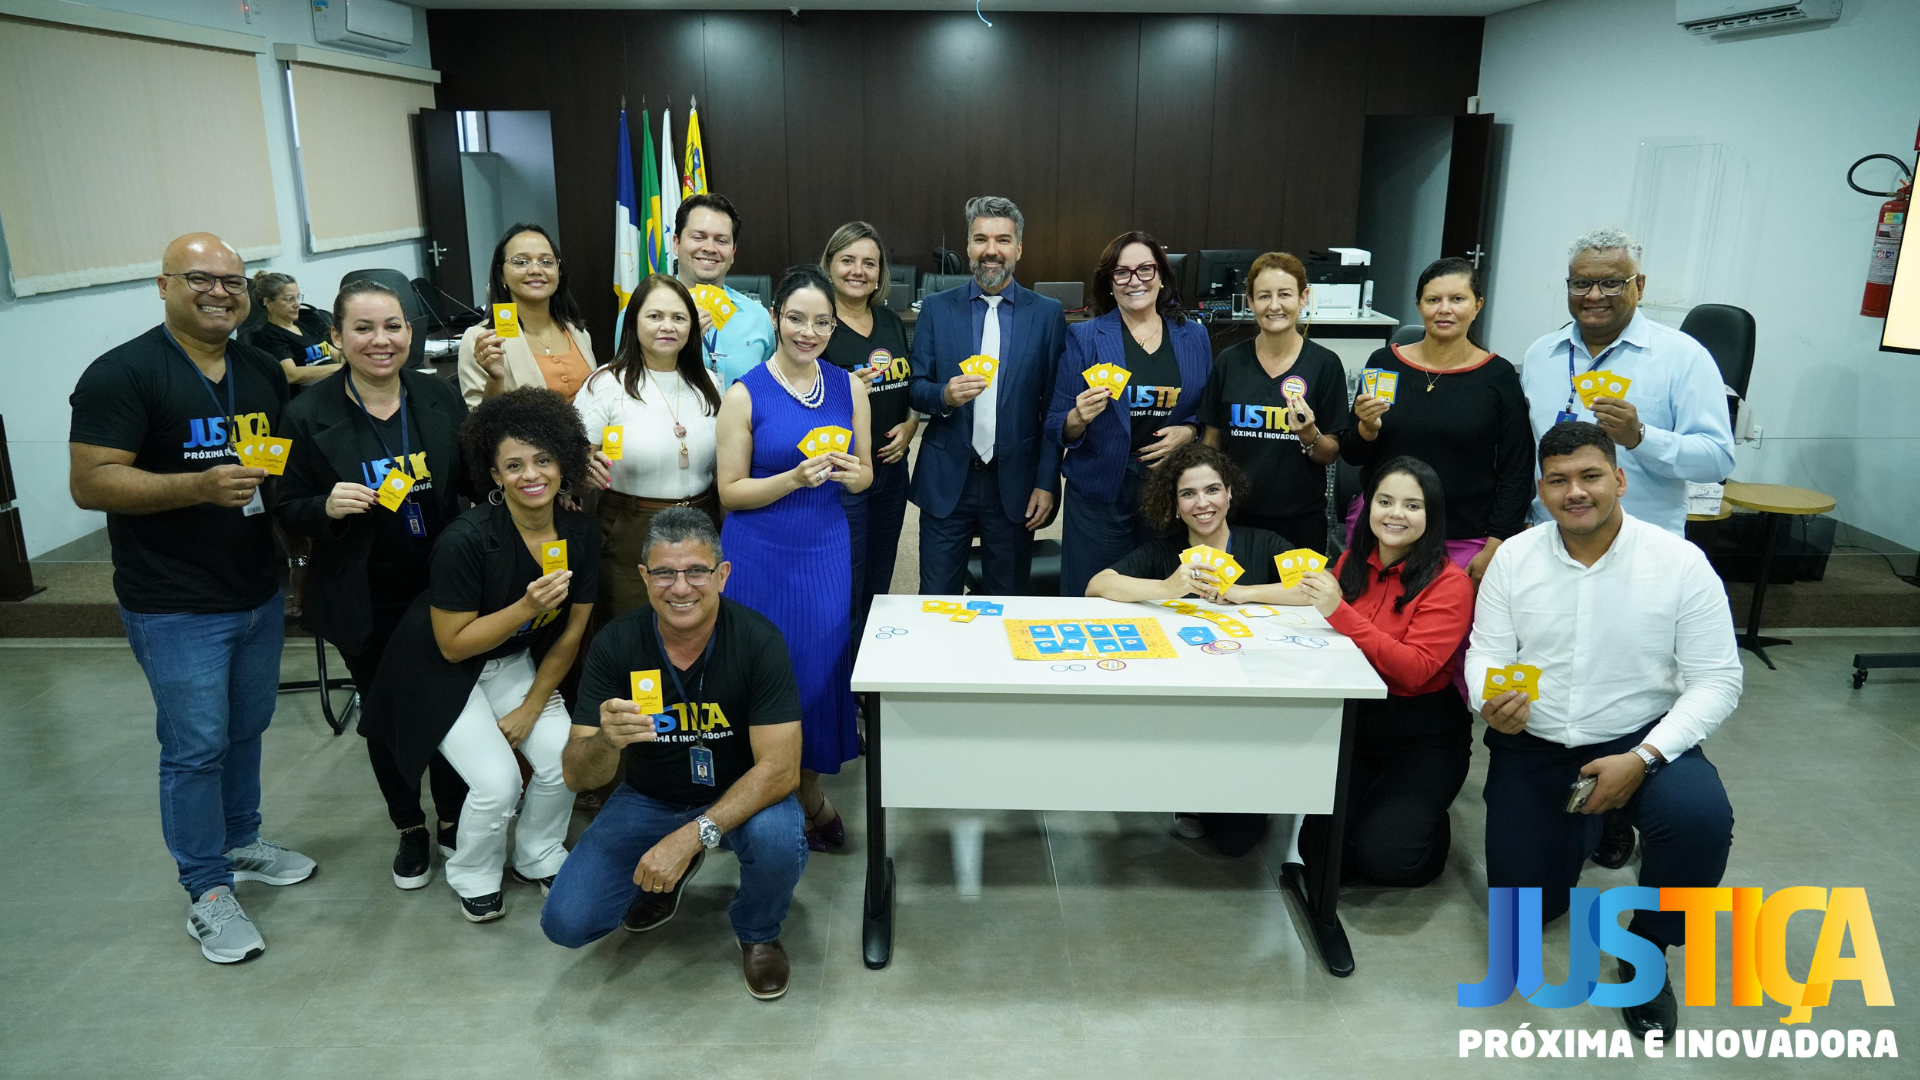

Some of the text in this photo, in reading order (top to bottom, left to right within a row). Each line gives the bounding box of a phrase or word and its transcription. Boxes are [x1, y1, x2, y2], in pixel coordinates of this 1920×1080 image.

[885, 380, 909, 391] INOVADO
[1229, 403, 1291, 433] JUSTIÇ
[1264, 432, 1300, 441] INOVADOR
[183, 449, 224, 460] PRÓXIMA
